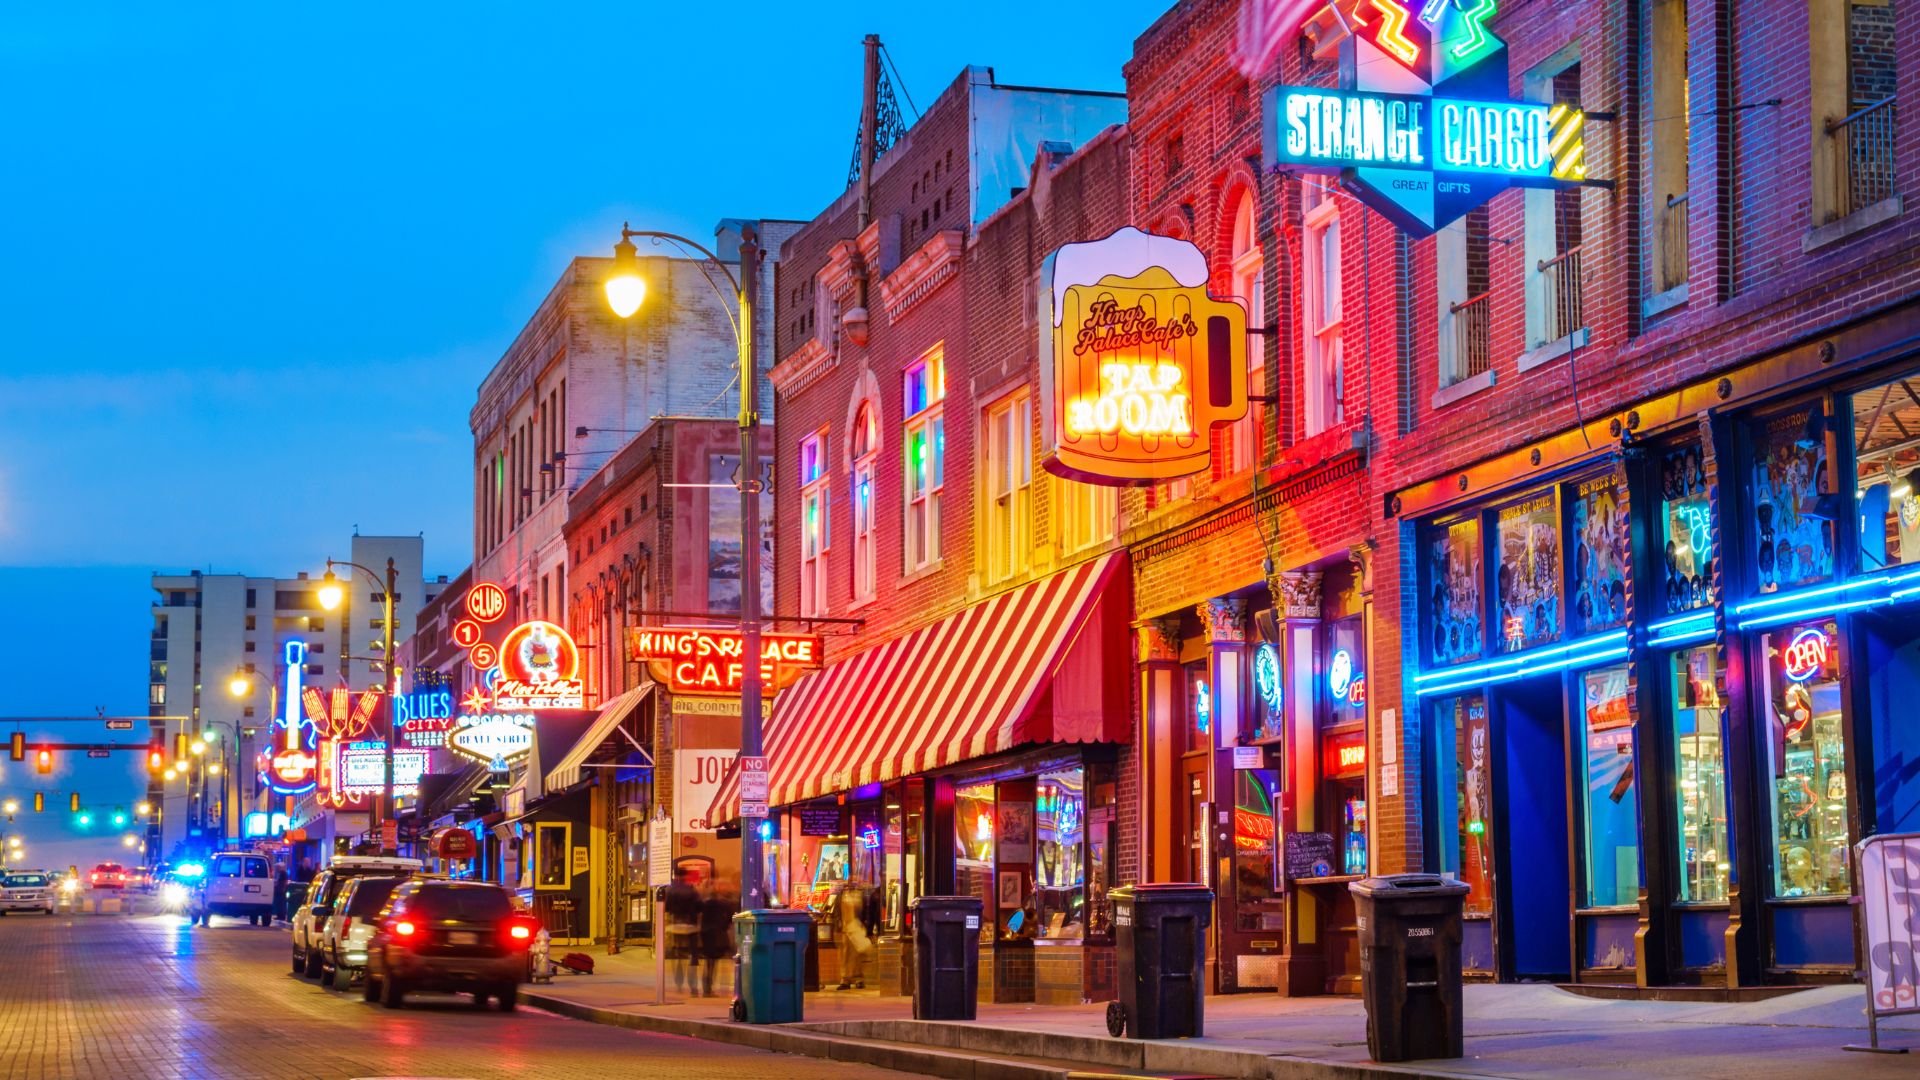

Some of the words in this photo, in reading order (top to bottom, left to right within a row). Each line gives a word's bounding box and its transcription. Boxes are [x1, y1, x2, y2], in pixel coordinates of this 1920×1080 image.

[1286, 93, 1423, 163] STRANGE
[1442, 103, 1545, 172] CARGO
[1392, 179, 1429, 191] GREAT
[1437, 181, 1470, 194] GIFTS
[1073, 324, 1141, 355] Palace
[1138, 313, 1198, 350] Cafe's
[1103, 363, 1182, 392] TAP
[1071, 393, 1192, 434] ROOM
[471, 587, 502, 617] CLUB
[461, 625, 471, 642] 1
[639, 631, 712, 656] KING'S
[477, 648, 490, 665] 5
[1785, 637, 1827, 673] OPEN
[394, 693, 450, 727] BLUES
[674, 702, 694, 712] AIR
[405, 719, 450, 731] CITY
[411, 737, 443, 746] STORE
[745, 760, 763, 770] NO
